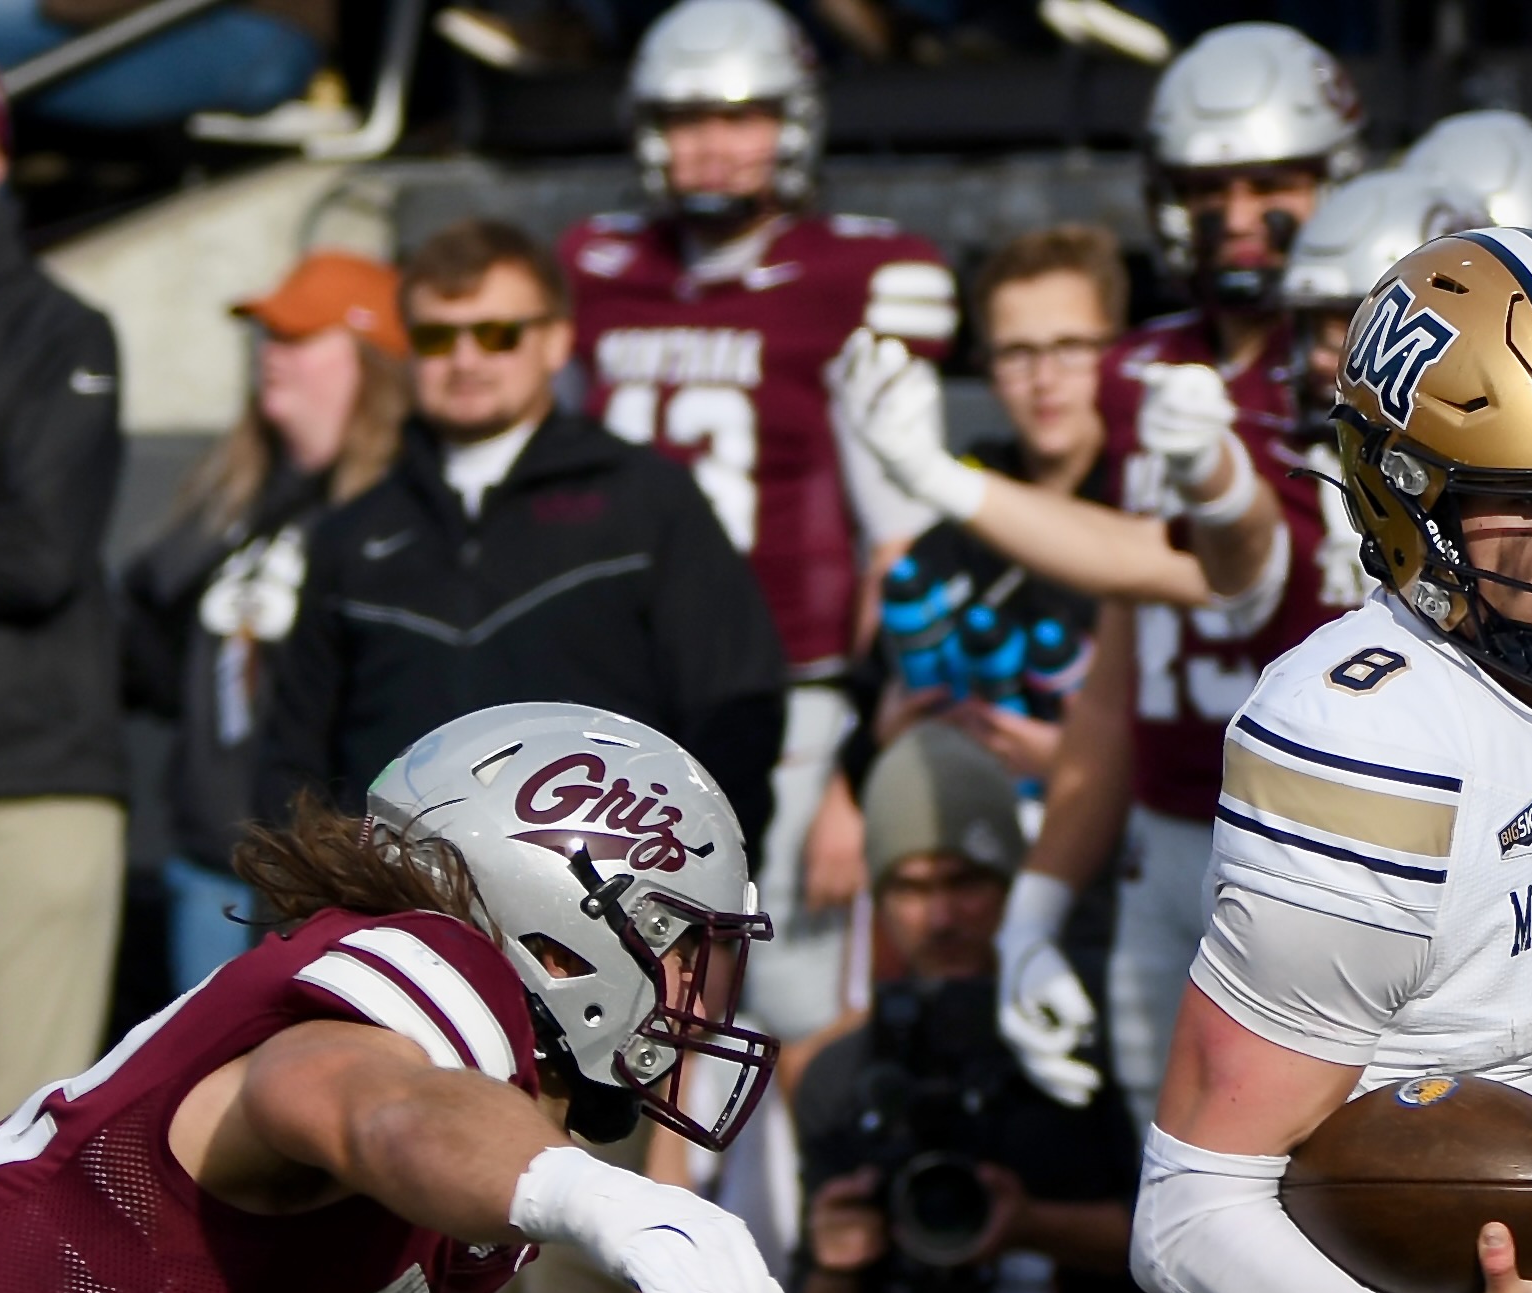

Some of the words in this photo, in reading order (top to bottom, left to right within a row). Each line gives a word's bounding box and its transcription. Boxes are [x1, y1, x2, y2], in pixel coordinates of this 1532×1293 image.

[1344, 279, 1460, 430] M
[1322, 645, 1413, 698] 8
[515, 753, 687, 873] Griz
